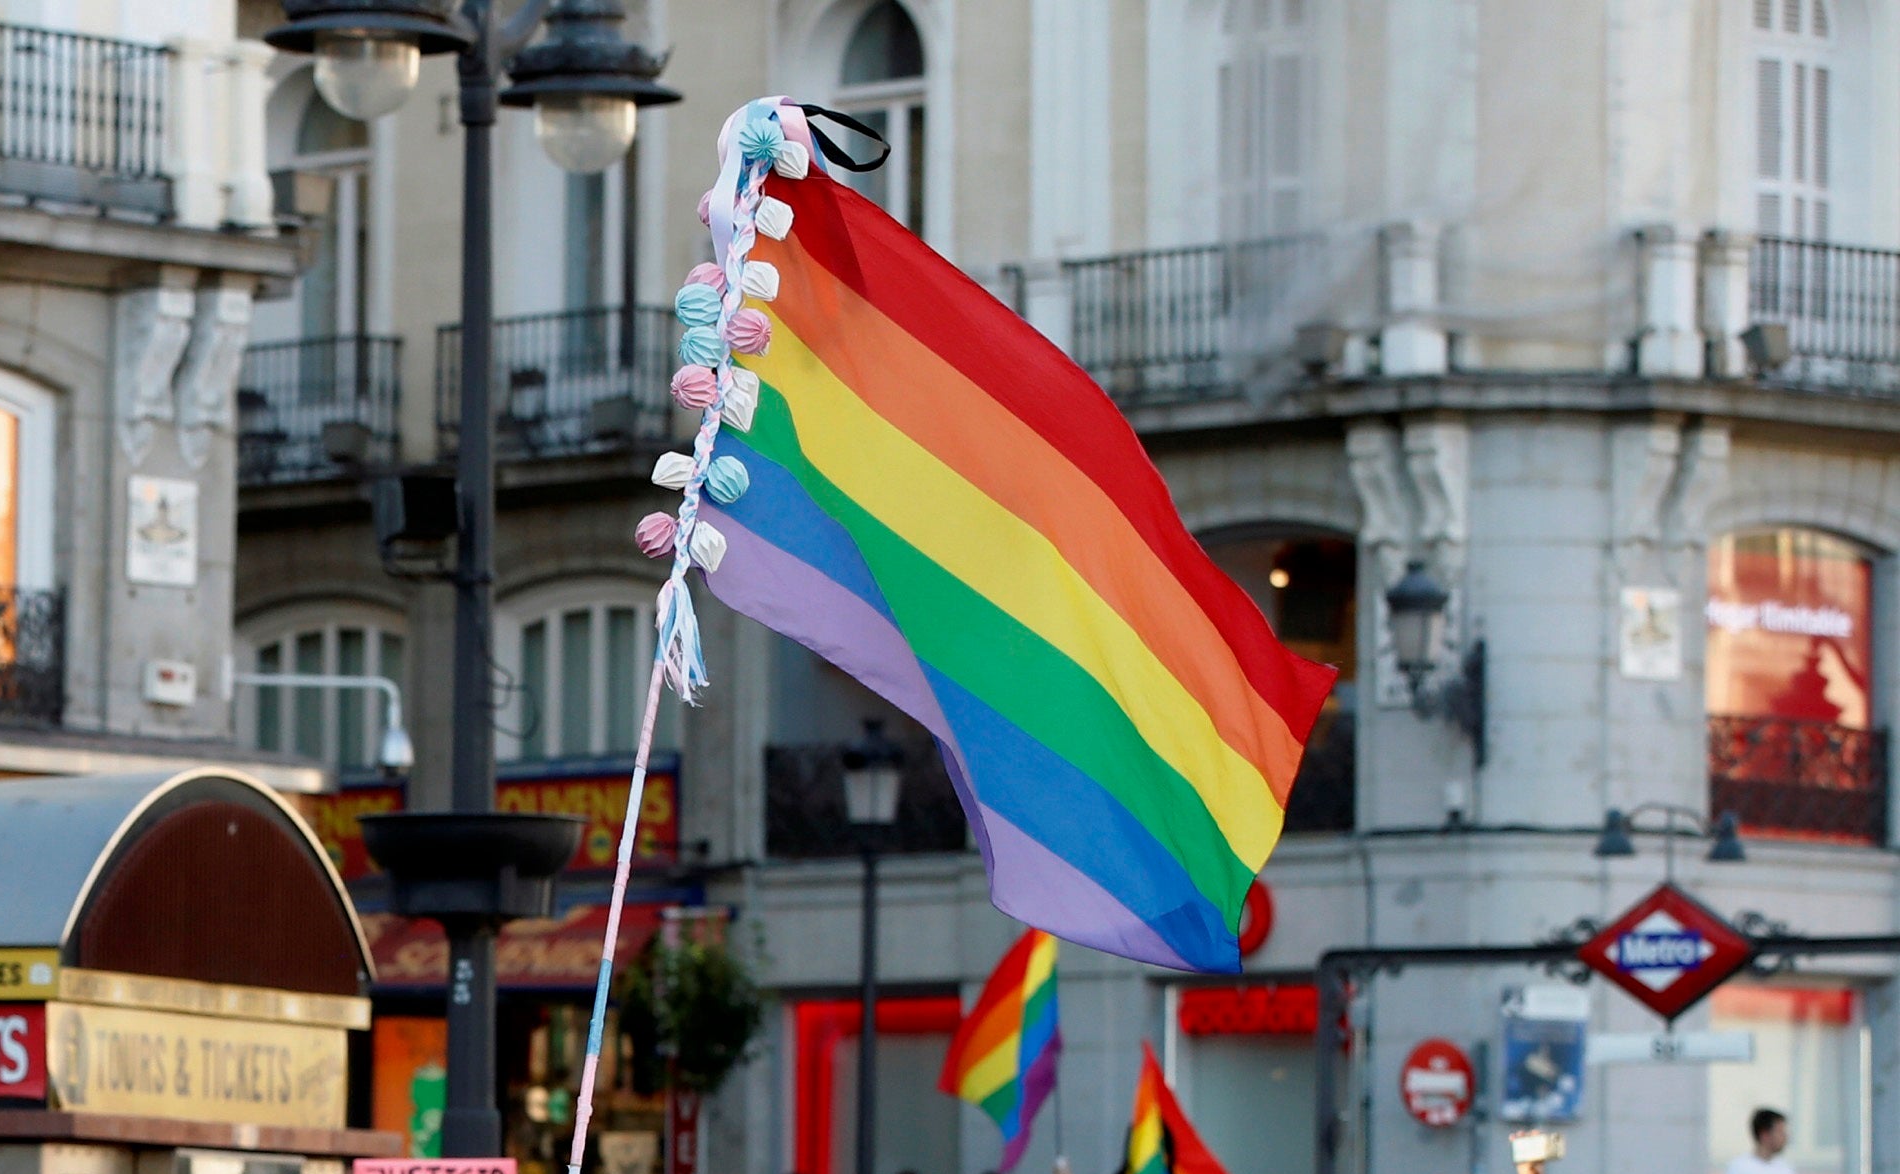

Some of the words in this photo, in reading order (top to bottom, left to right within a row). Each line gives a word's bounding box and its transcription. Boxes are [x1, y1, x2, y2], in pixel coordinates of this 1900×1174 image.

[1622, 936, 1696, 967] Metro
[97, 1029, 166, 1095] TOURS
[175, 1036, 191, 1097] &
[200, 1040, 293, 1105] TICKETS
